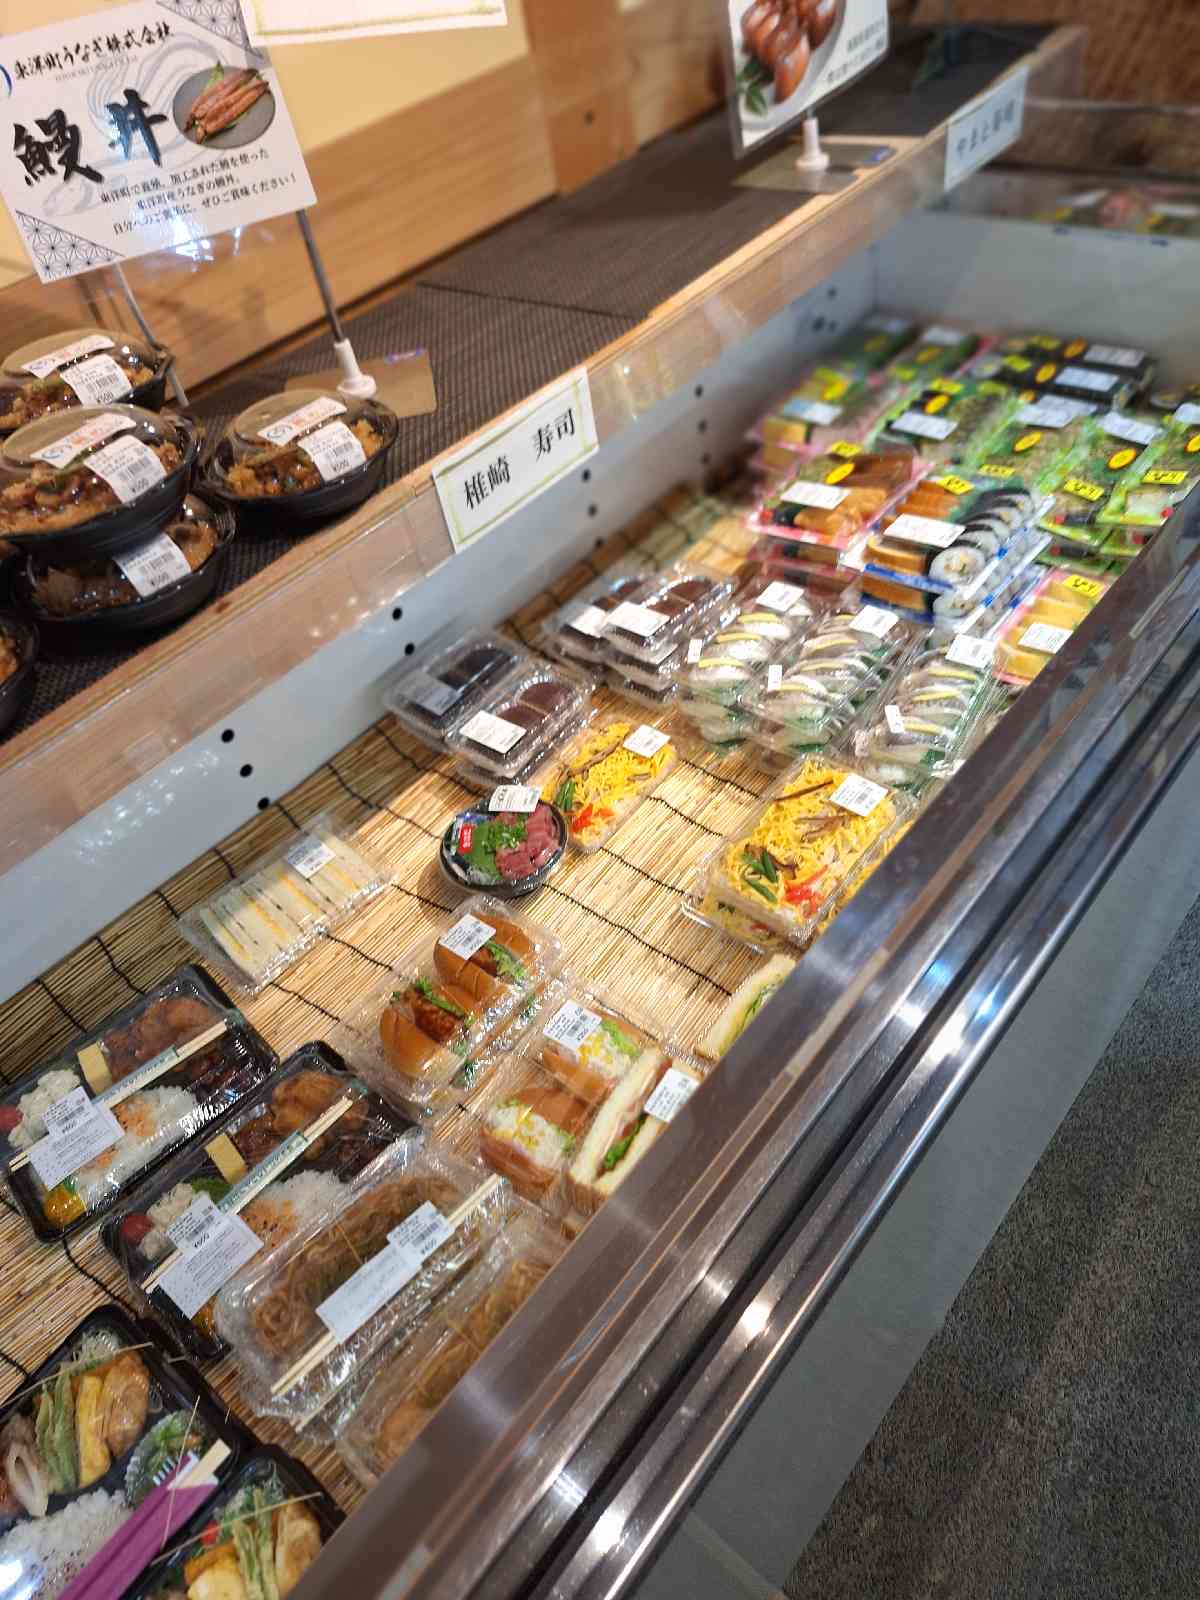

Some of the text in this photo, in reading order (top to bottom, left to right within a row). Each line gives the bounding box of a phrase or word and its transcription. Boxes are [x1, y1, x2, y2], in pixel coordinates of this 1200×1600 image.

[15, 21, 173, 79] 東洋町うなぎ株式会社
[13, 88, 168, 186] 鰻 丼
[464, 408, 576, 510] 椎崎 寿司
